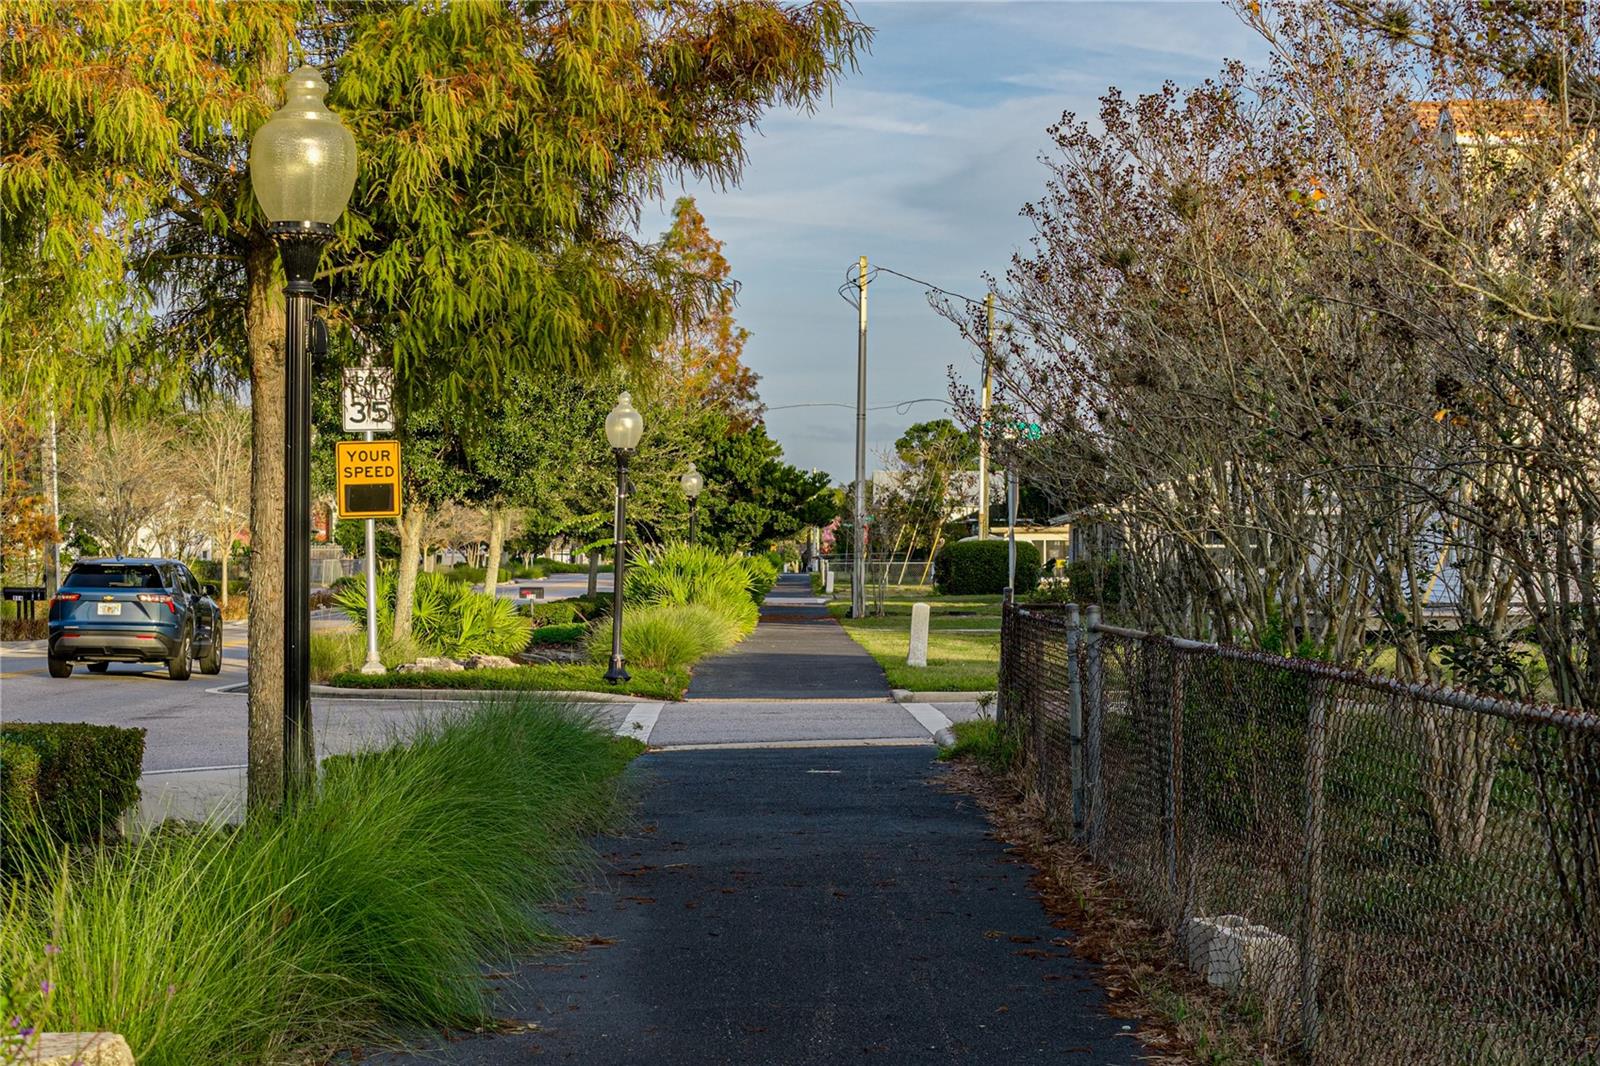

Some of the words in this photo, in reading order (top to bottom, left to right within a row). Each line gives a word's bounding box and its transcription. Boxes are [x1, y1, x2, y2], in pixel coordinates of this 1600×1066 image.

[349, 401, 389, 423] 35
[346, 450, 391, 462] YOUR
[344, 466, 395, 478] SPEED
